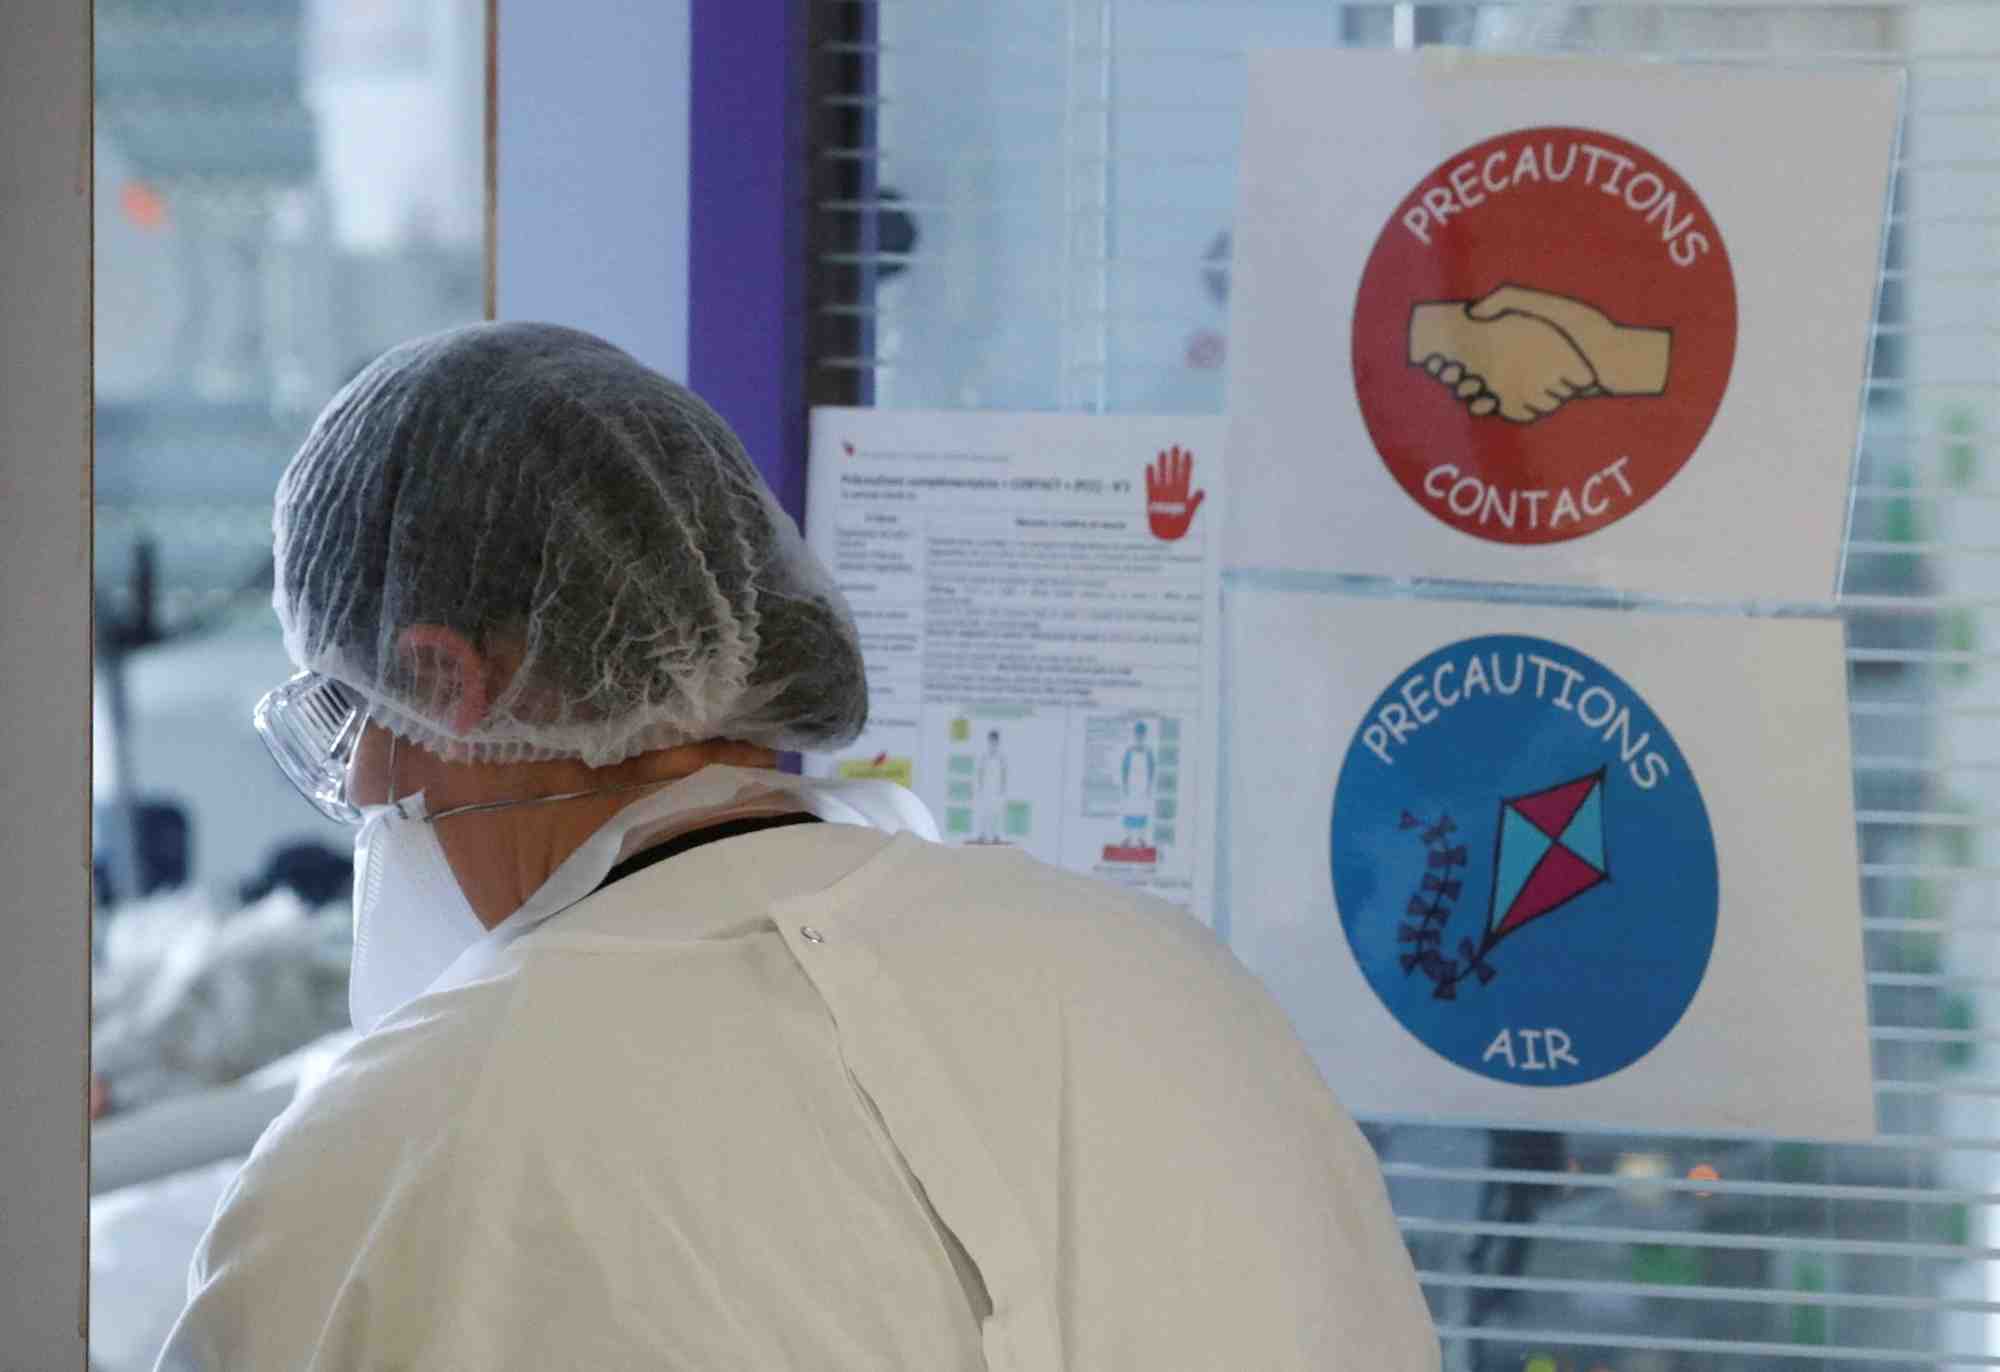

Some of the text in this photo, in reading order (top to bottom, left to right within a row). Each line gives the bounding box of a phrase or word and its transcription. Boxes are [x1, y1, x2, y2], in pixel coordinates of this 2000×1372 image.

[1403, 143, 1709, 266] PRECAUTIONS
[1424, 456, 1633, 528] CONTACT
[1362, 653, 1669, 790] PRECAUTIONS
[1482, 1027, 1579, 1069] AIR
